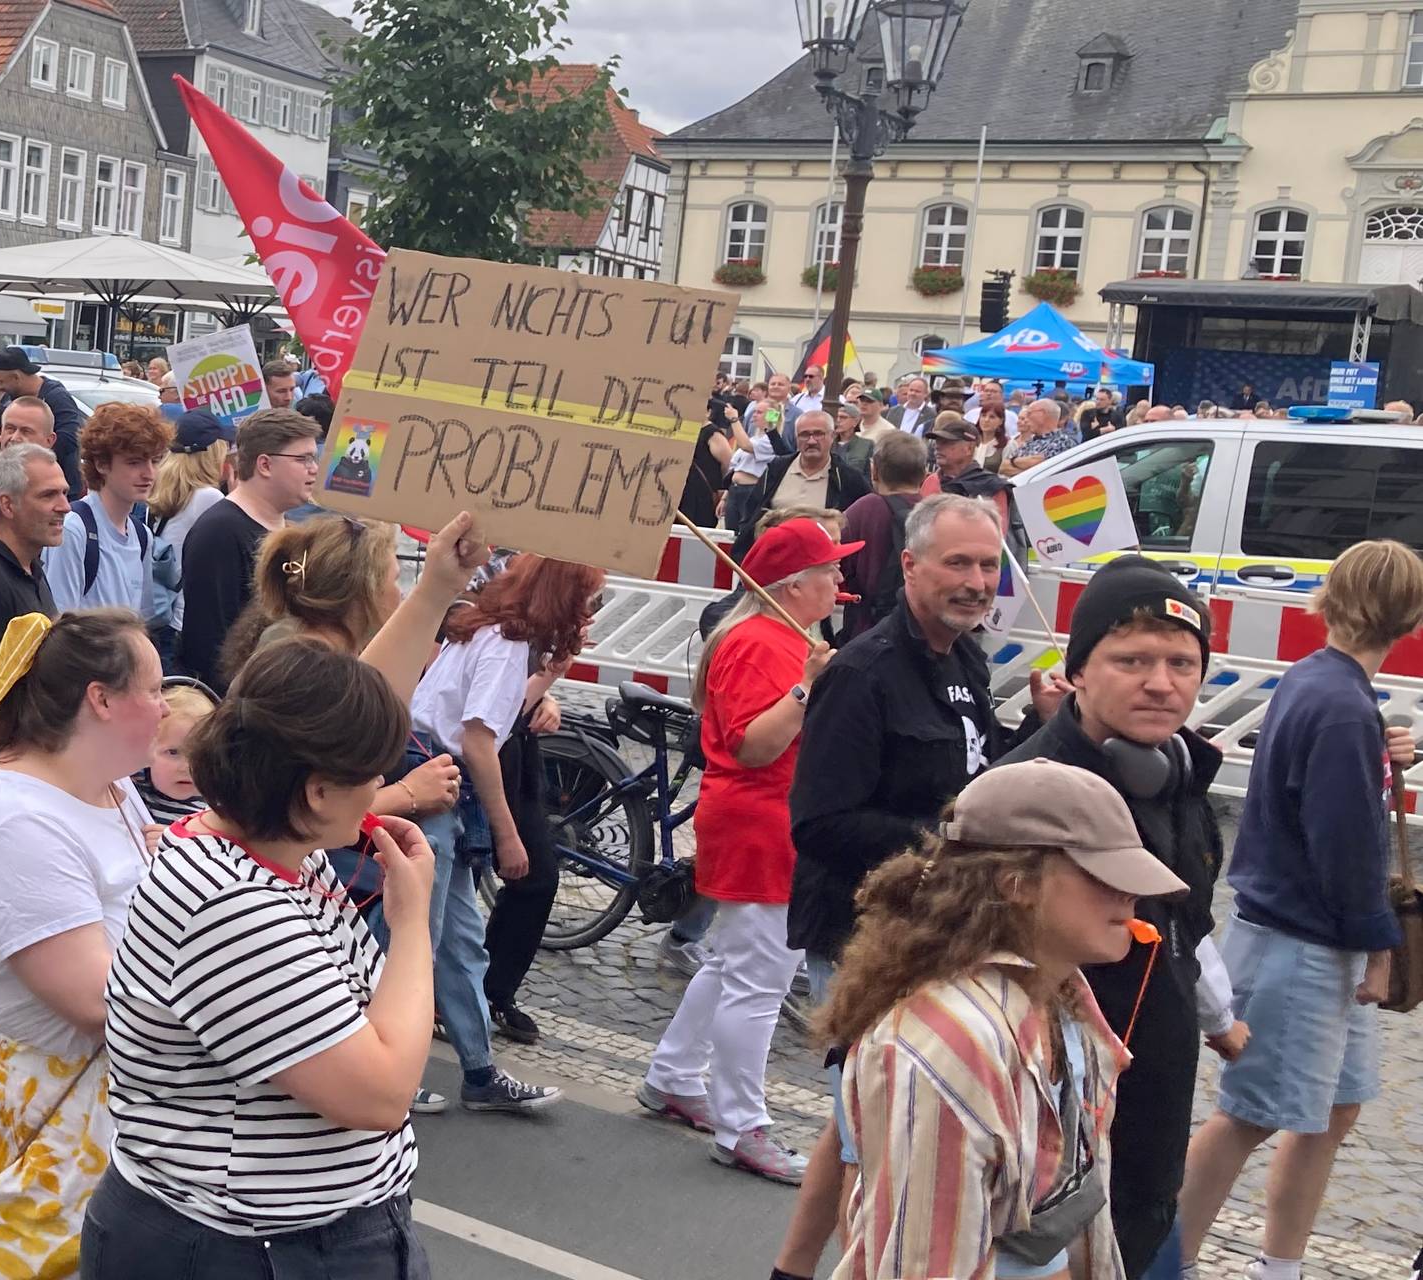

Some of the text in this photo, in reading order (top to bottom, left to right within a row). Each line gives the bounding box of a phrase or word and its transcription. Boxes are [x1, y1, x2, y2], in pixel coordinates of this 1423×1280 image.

[388, 266, 726, 348] WER NICHTS TUT
[988, 328, 1050, 349] AfD
[184, 361, 250, 399] STOPPT
[1060, 361, 1084, 374] AfD
[209, 386, 248, 417] AFD
[374, 343, 694, 437] IST TEIL DES
[393, 414, 681, 526] PROBLEMS
[947, 685, 976, 705] FAS
